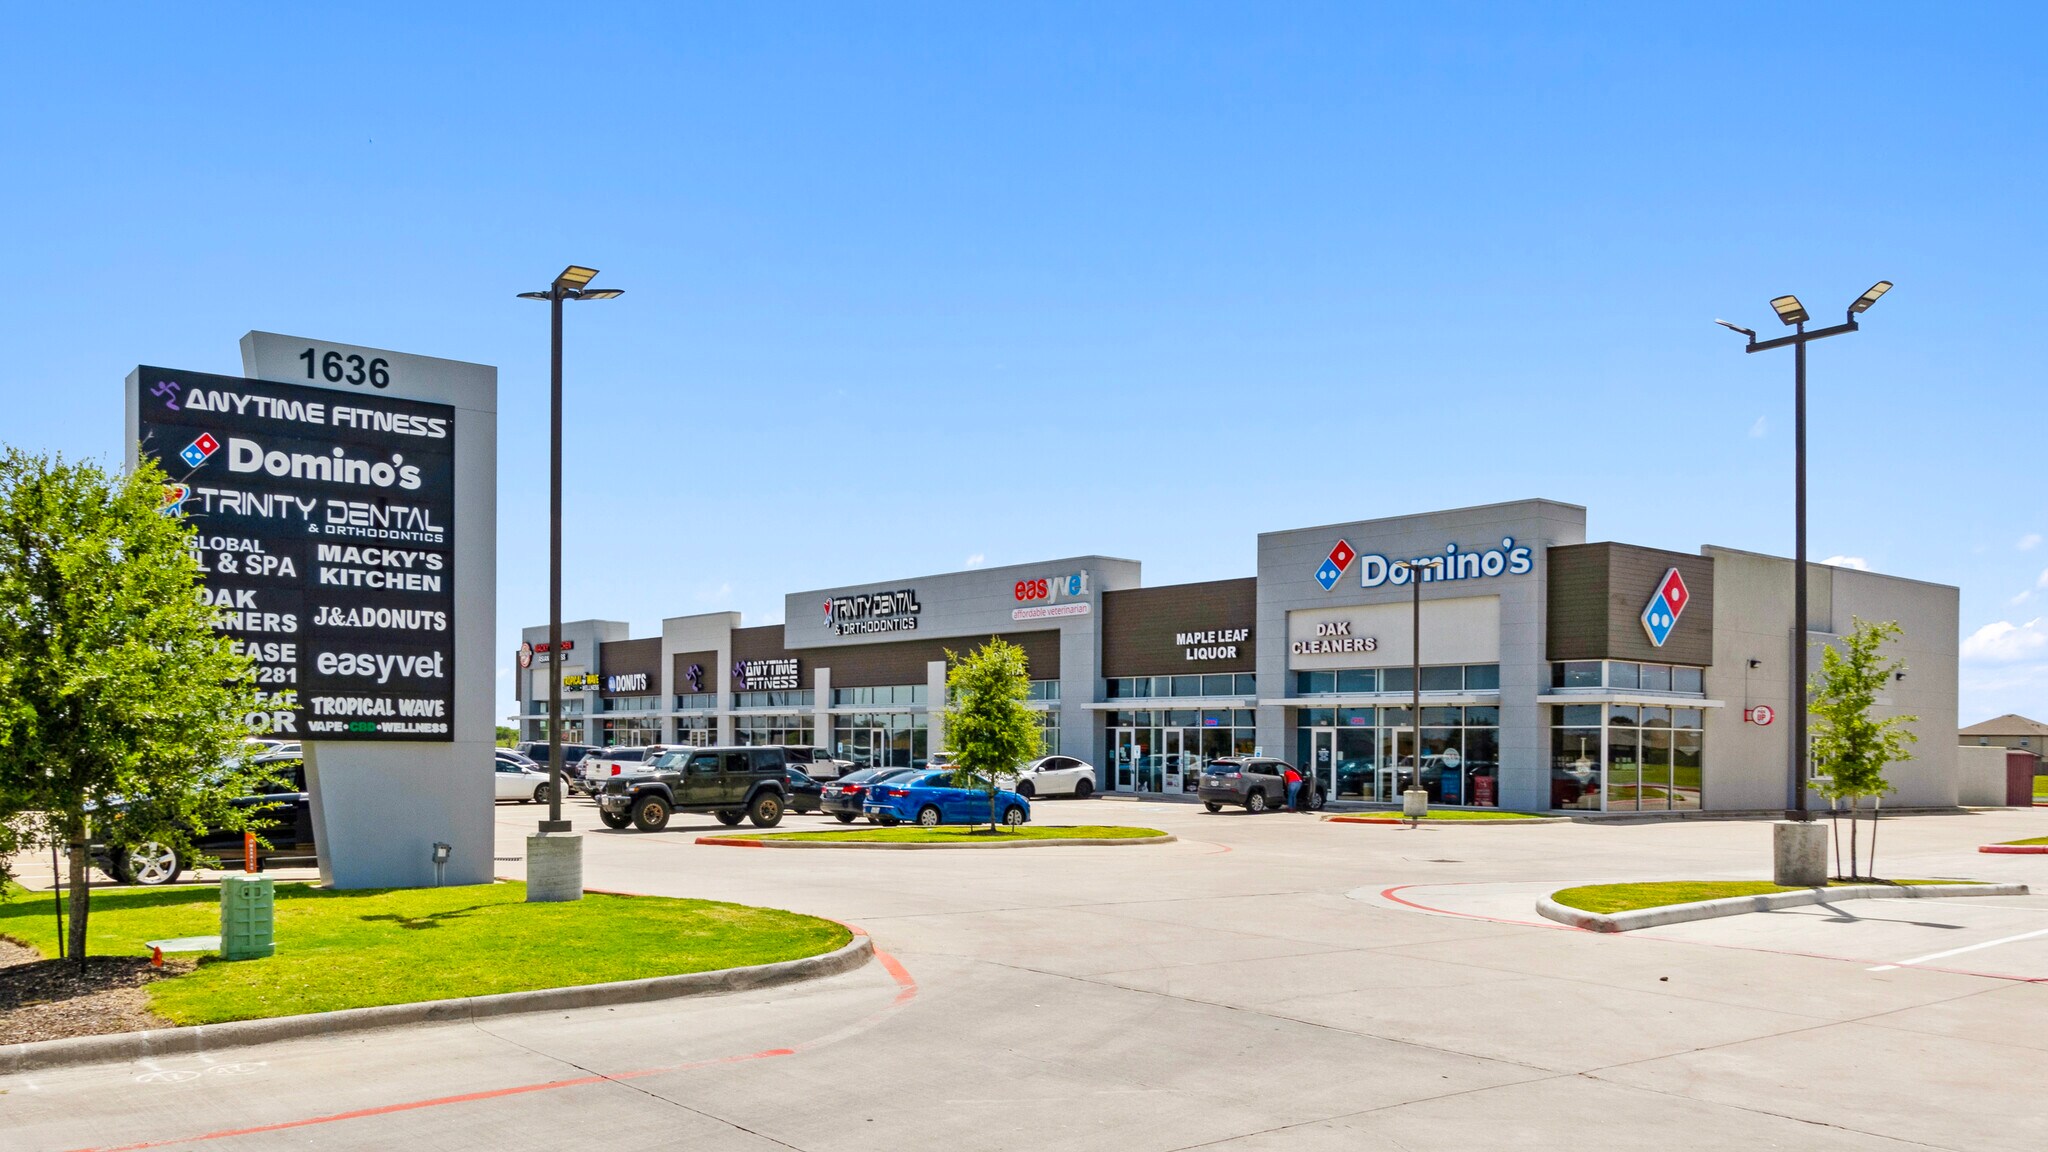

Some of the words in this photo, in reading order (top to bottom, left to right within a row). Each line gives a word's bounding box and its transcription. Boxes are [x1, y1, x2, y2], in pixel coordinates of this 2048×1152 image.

[299, 347, 390, 388] 1636
[185, 388, 325, 425] ANYTIME
[332, 406, 447, 439] FITNESS
[228, 437, 422, 490] Domino's
[197, 487, 317, 521] TRINITY
[327, 500, 444, 532] DENTAL
[308, 523, 319, 534] &
[324, 525, 444, 543] ORTHODONTICS
[184, 535, 266, 554] GLOBAL
[217, 552, 239, 574] &
[245, 554, 297, 577] SPA
[317, 544, 443, 570] MACKY'S
[1361, 537, 1532, 588] Domino's
[319, 567, 441, 592] KITCHEN
[1015, 569, 1089, 604] easyvet
[874, 592, 918, 614] DENTAL
[1013, 608, 1046, 618] affordable
[1048, 604, 1087, 615] veterinarian
[199, 610, 298, 633] ANERS
[843, 617, 915, 634] ORTHODONTICS
[1316, 622, 1349, 637] DAK
[1176, 631, 1216, 645] MAPLE
[1218, 629, 1249, 642] LEAF
[1291, 637, 1376, 654] CLEANERS
[1186, 646, 1237, 660] LIQUOR
[317, 650, 443, 684] easyvet
[745, 659, 798, 676] ANYTIME
[616, 673, 647, 692] DONUTS
[746, 676, 798, 690] FITNESS
[311, 696, 396, 716] TROPICAL
[398, 698, 445, 717] WAVE
